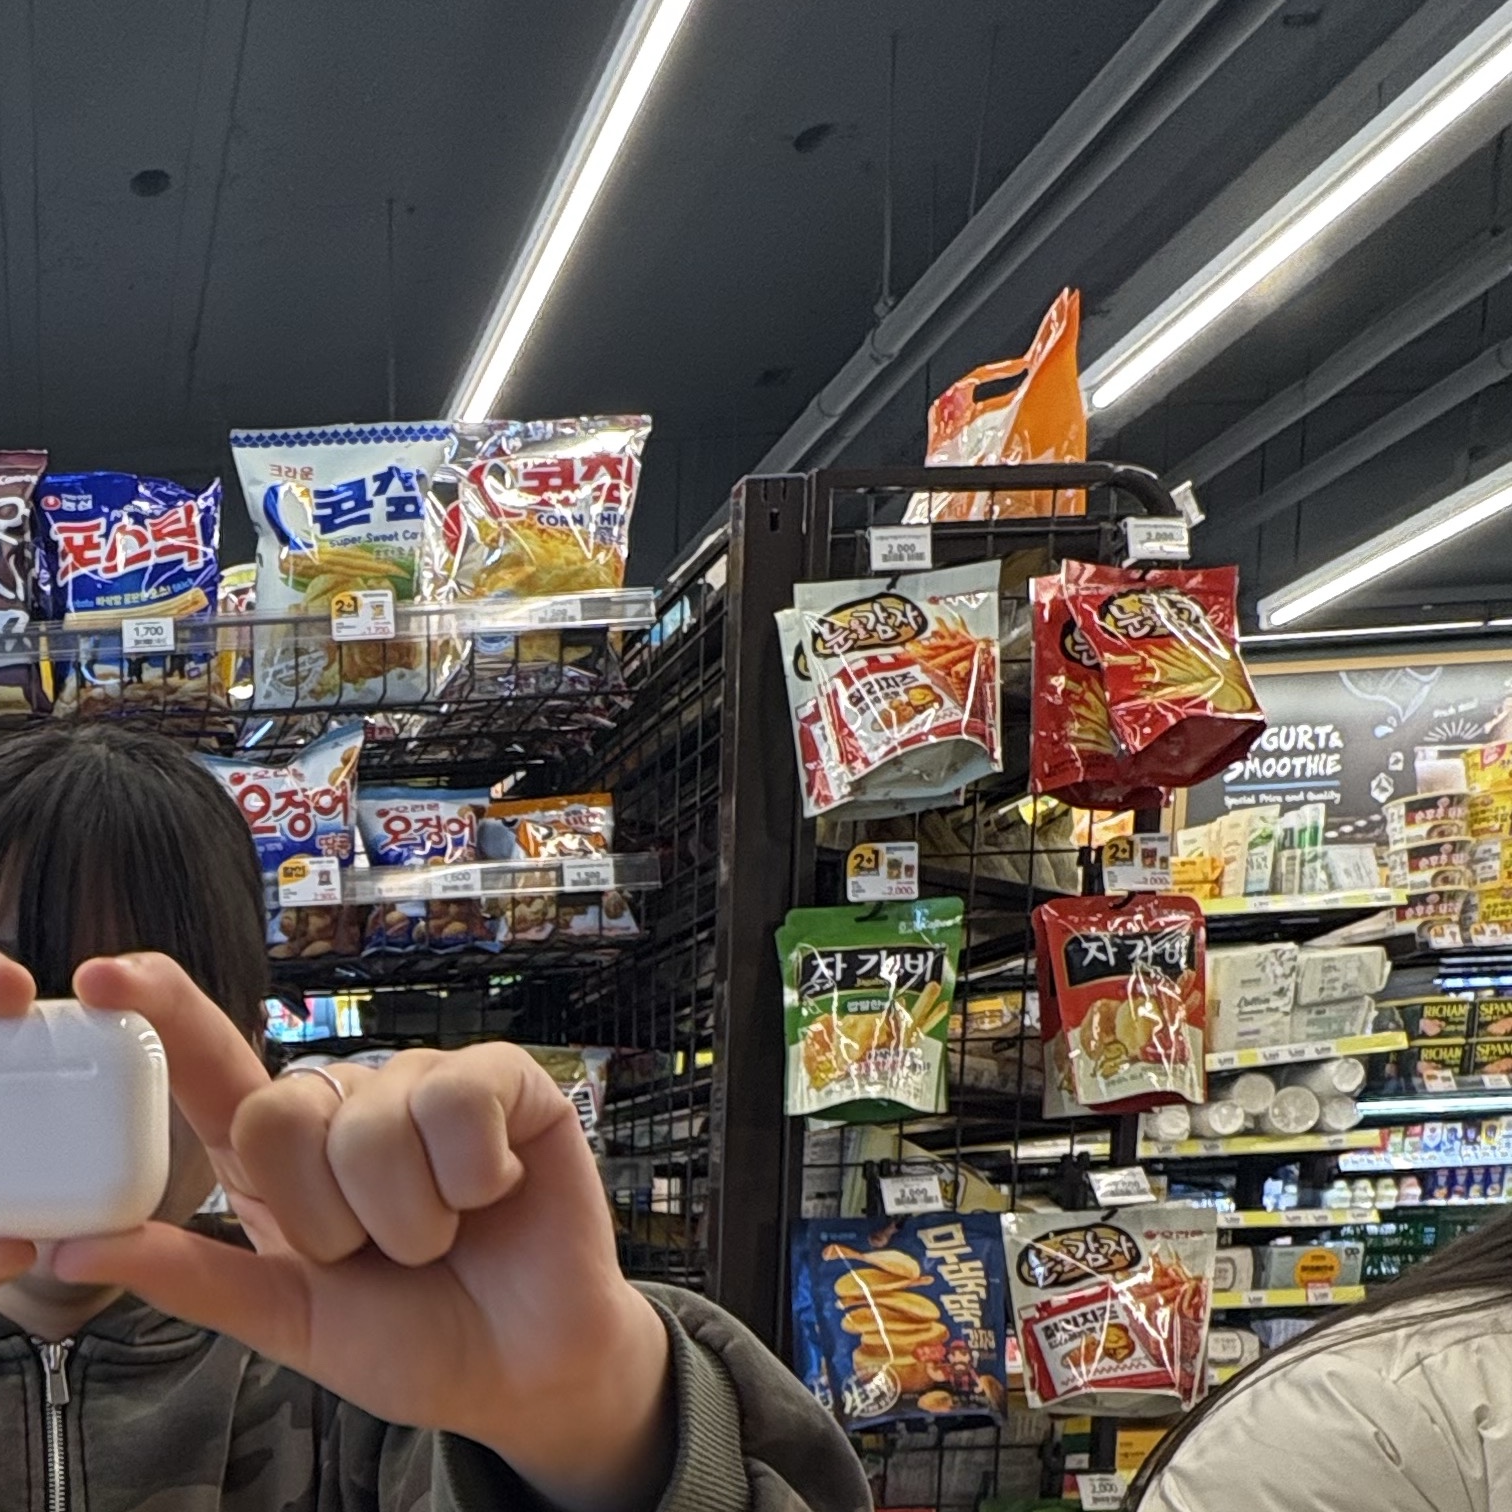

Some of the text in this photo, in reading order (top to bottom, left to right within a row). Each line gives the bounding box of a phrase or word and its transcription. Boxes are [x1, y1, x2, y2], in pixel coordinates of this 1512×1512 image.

[50, 500, 205, 588] 포스틱
[888, 542, 917, 555] 2,000
[134, 625, 164, 637] 1,700
[812, 599, 924, 654] 눈을감자
[237, 778, 352, 843] 오징어
[382, 813, 477, 852] 오징어
[853, 851, 880, 872] 2+1
[1090, 1482, 1119, 1495] 2,000
